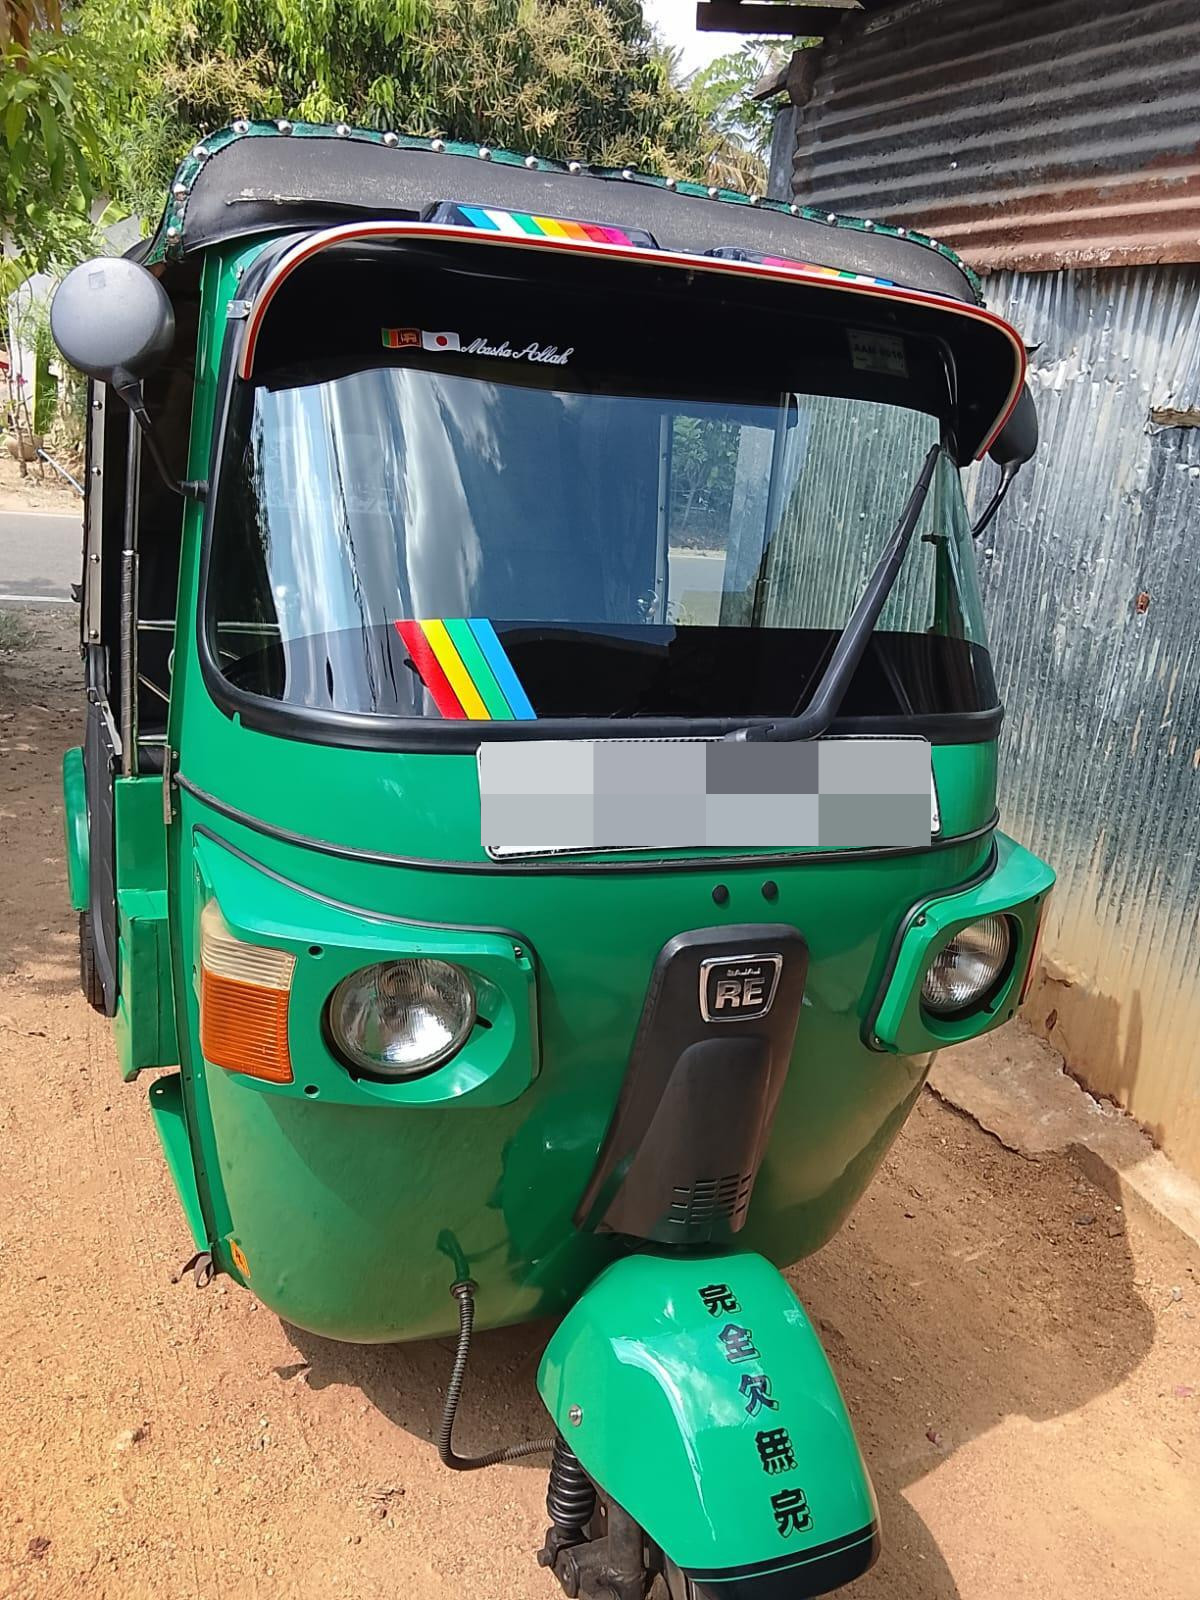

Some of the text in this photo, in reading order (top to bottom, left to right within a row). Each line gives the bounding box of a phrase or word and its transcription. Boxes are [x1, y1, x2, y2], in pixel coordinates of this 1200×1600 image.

[462, 338, 574, 365] Masha Allah
[715, 977, 765, 1008] RE
